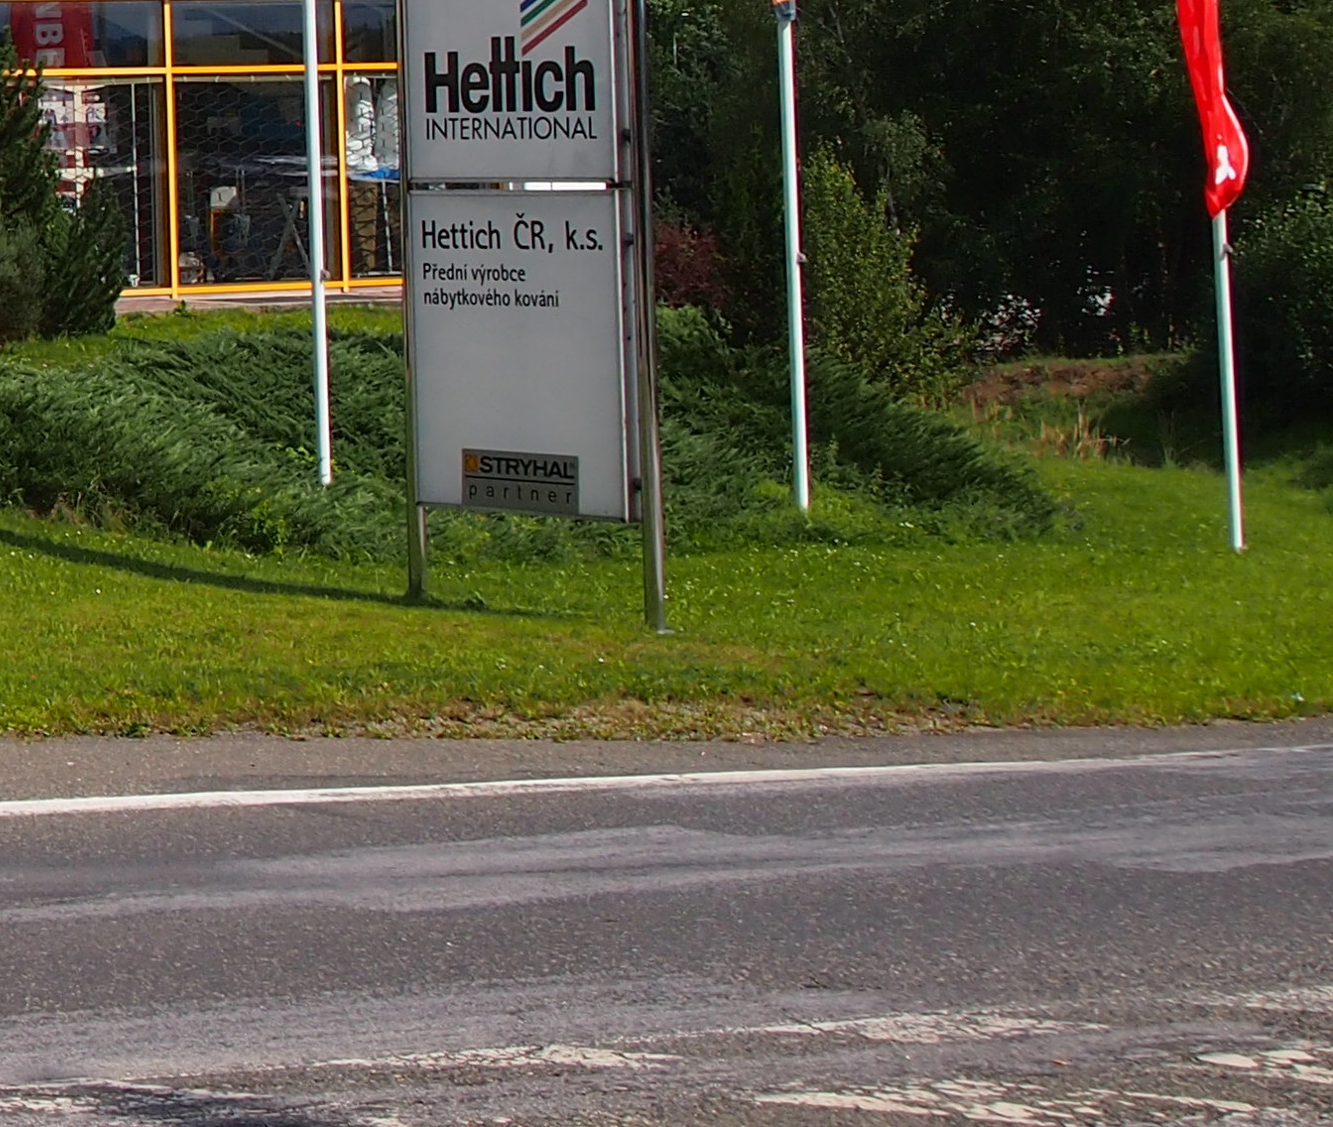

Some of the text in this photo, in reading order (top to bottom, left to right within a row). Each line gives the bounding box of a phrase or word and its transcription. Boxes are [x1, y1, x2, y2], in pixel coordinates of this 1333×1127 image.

[424, 35, 596, 113] Hettich
[425, 116, 597, 141] INTERNATIONAL
[421, 212, 604, 254] Hettich ČR, k.s.
[422, 262, 526, 286] Přední výrobce
[423, 287, 511, 311] nábytkového
[468, 482, 573, 504] partner
